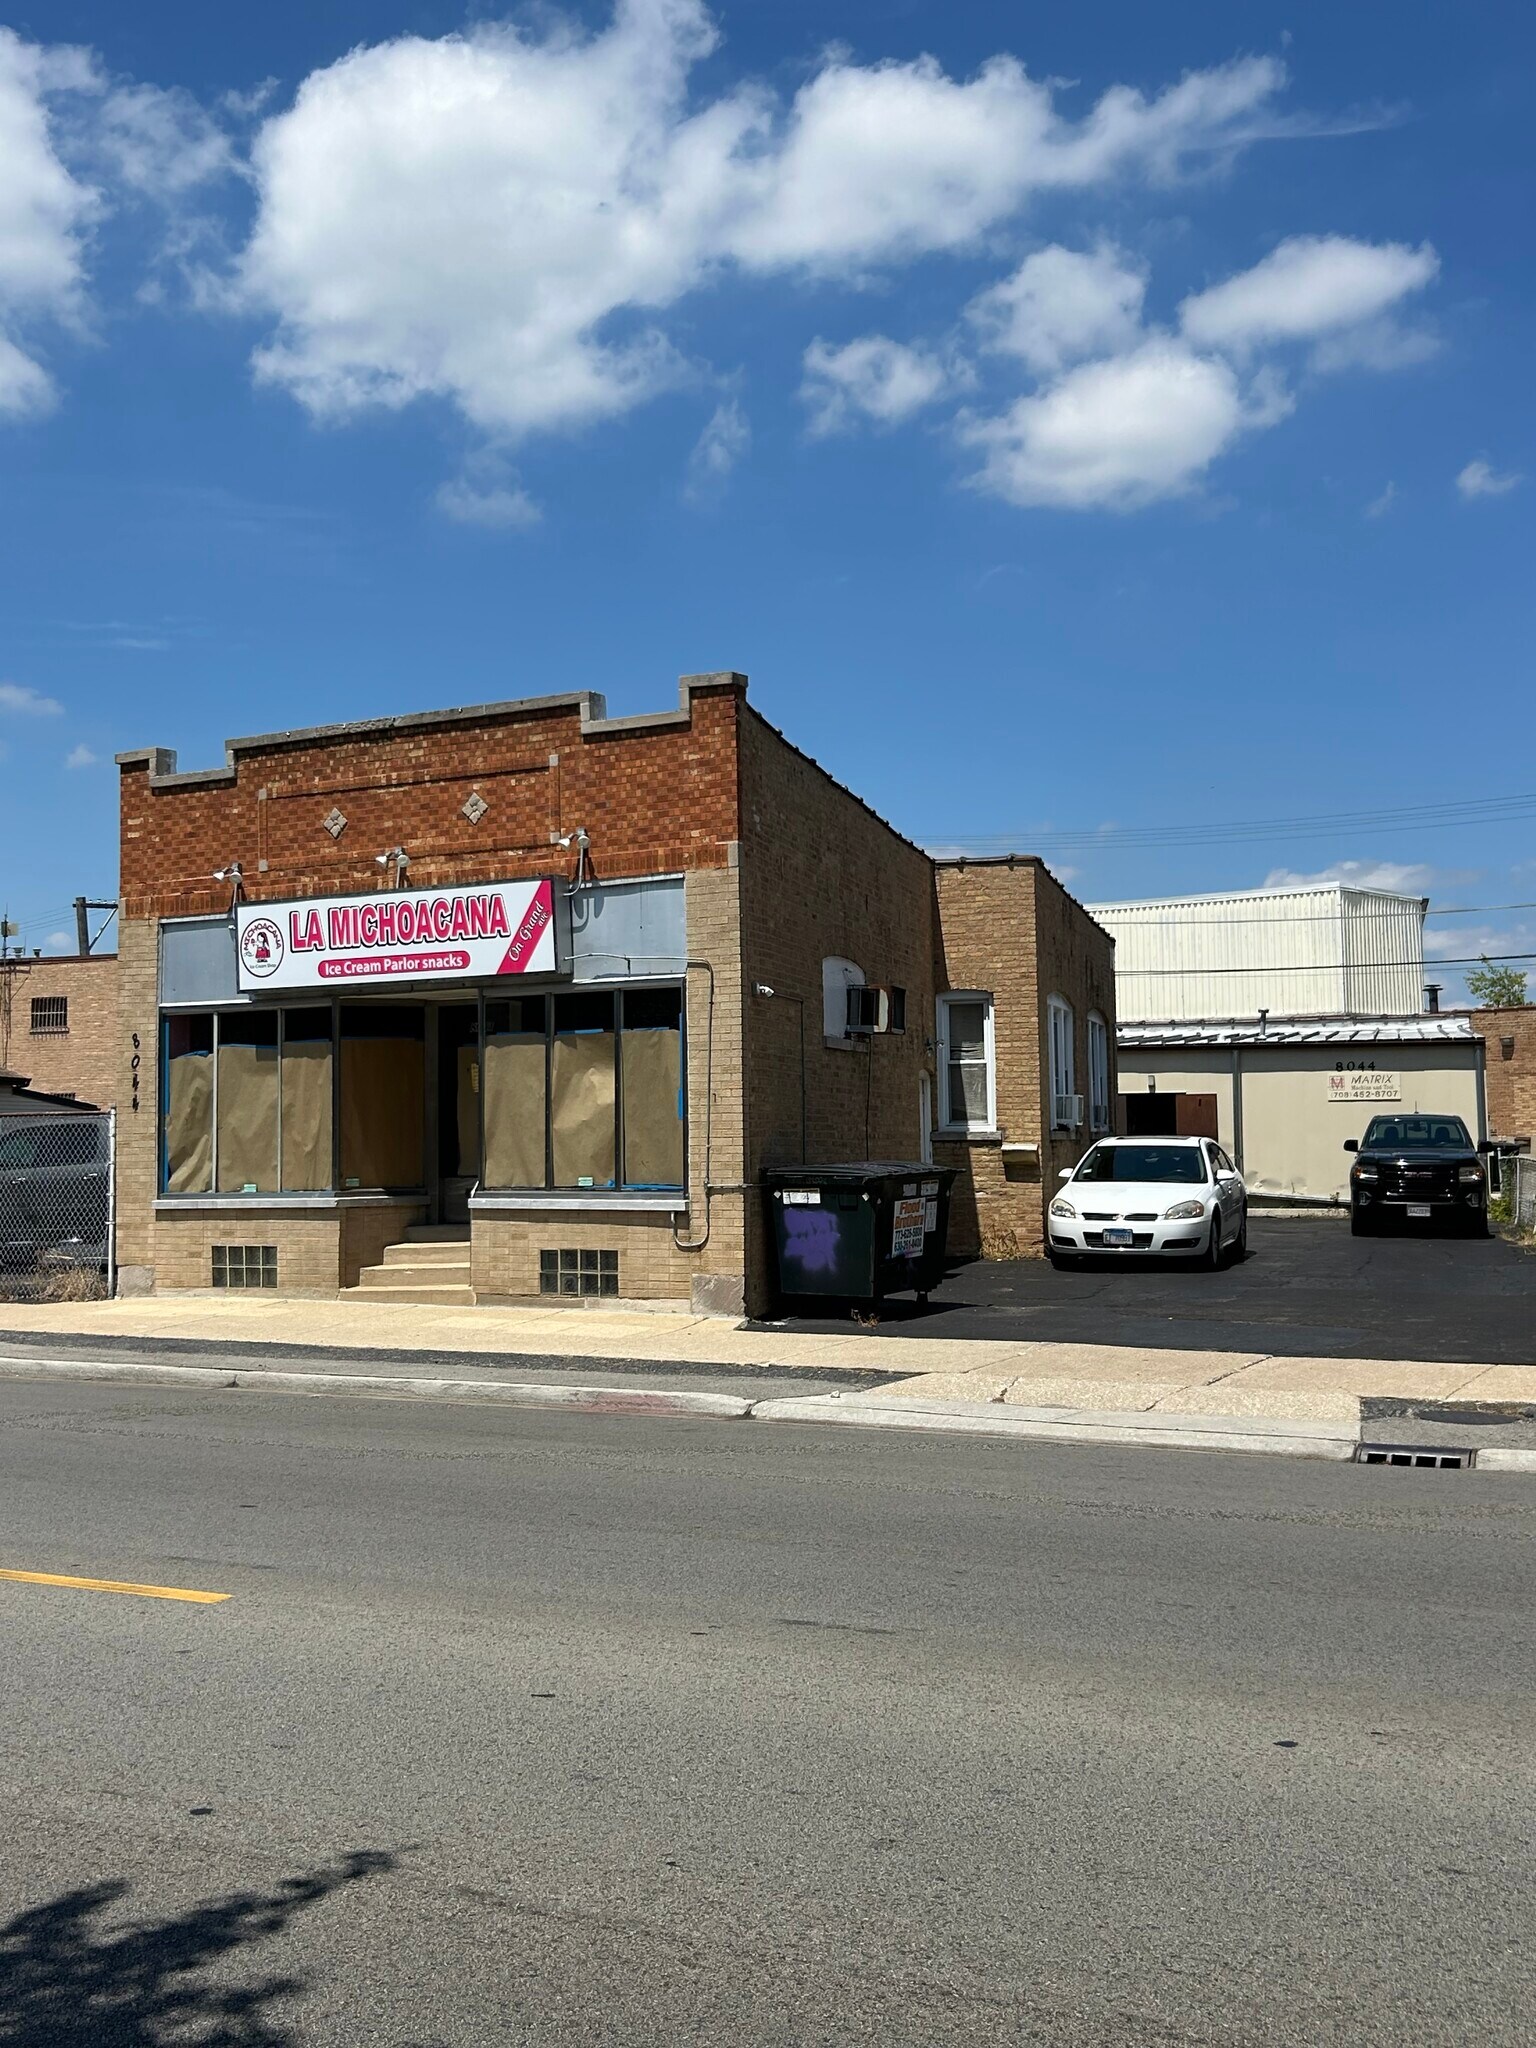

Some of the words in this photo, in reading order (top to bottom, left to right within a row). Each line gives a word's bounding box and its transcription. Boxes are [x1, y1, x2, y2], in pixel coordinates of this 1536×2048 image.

[290, 909, 326, 953] LA
[328, 893, 511, 950] MICHOACANA
[509, 942, 524, 961] On
[520, 900, 544, 940] Grand
[244, 923, 281, 951] MICHOACANA
[325, 962, 342, 975] Ice
[344, 960, 381, 974] Cream
[384, 956, 420, 971] Parlor
[422, 954, 463, 969] snacks
[131, 1033, 140, 1113] 8044
[1335, 1061, 1376, 1072] 8044
[1351, 1074, 1393, 1084] MATRIX
[1353, 1090, 1399, 1098] 452-8707
